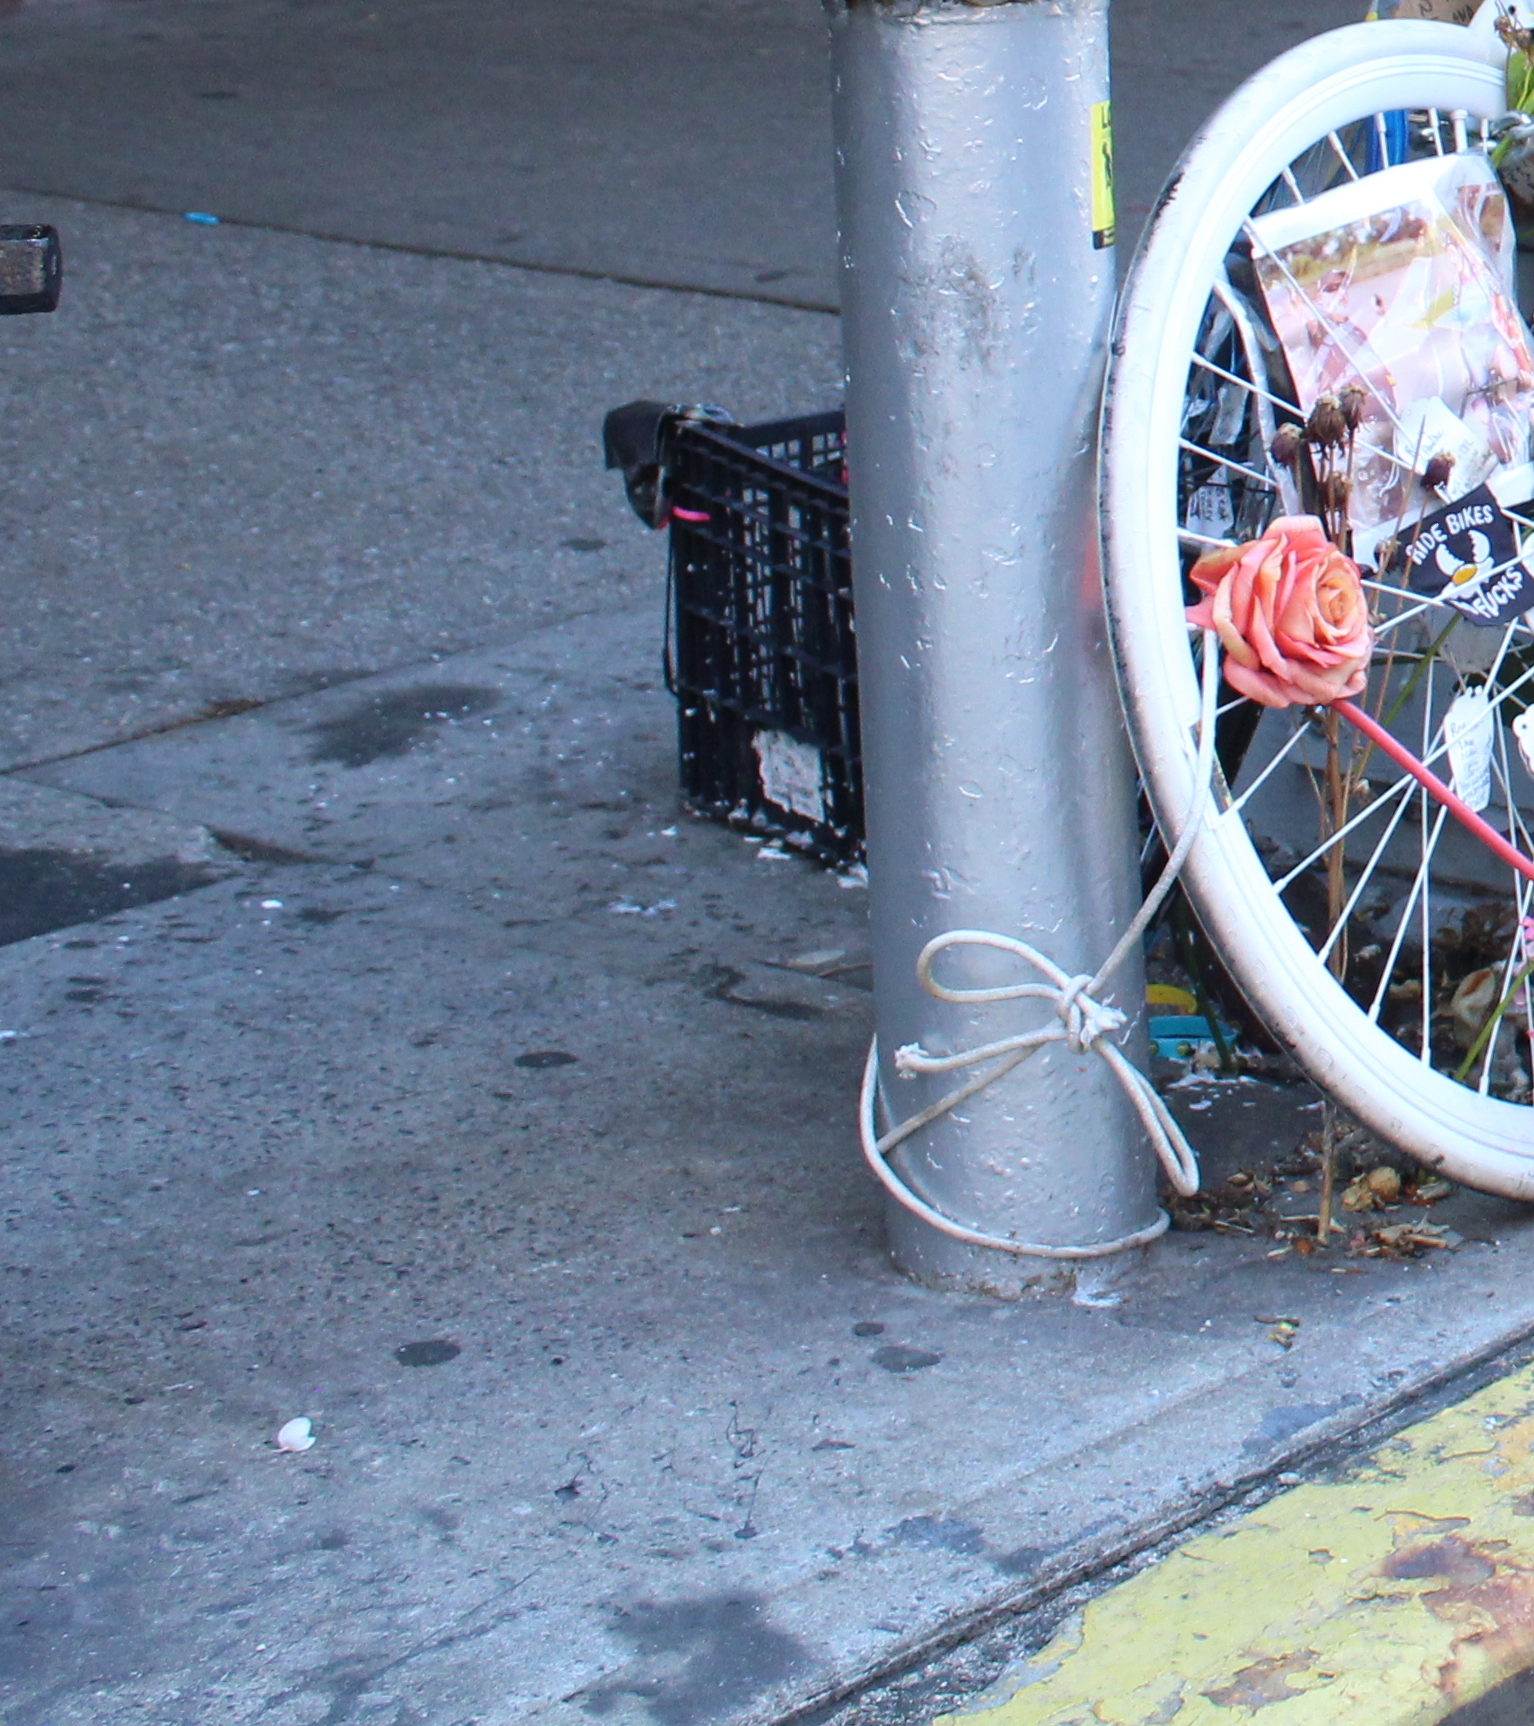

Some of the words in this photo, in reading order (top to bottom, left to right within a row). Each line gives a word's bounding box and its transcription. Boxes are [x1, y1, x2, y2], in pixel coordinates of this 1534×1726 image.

[1405, 523, 1448, 566] RIDE
[1444, 504, 1495, 536] BIKES
[1471, 566, 1525, 619] FUCKS
